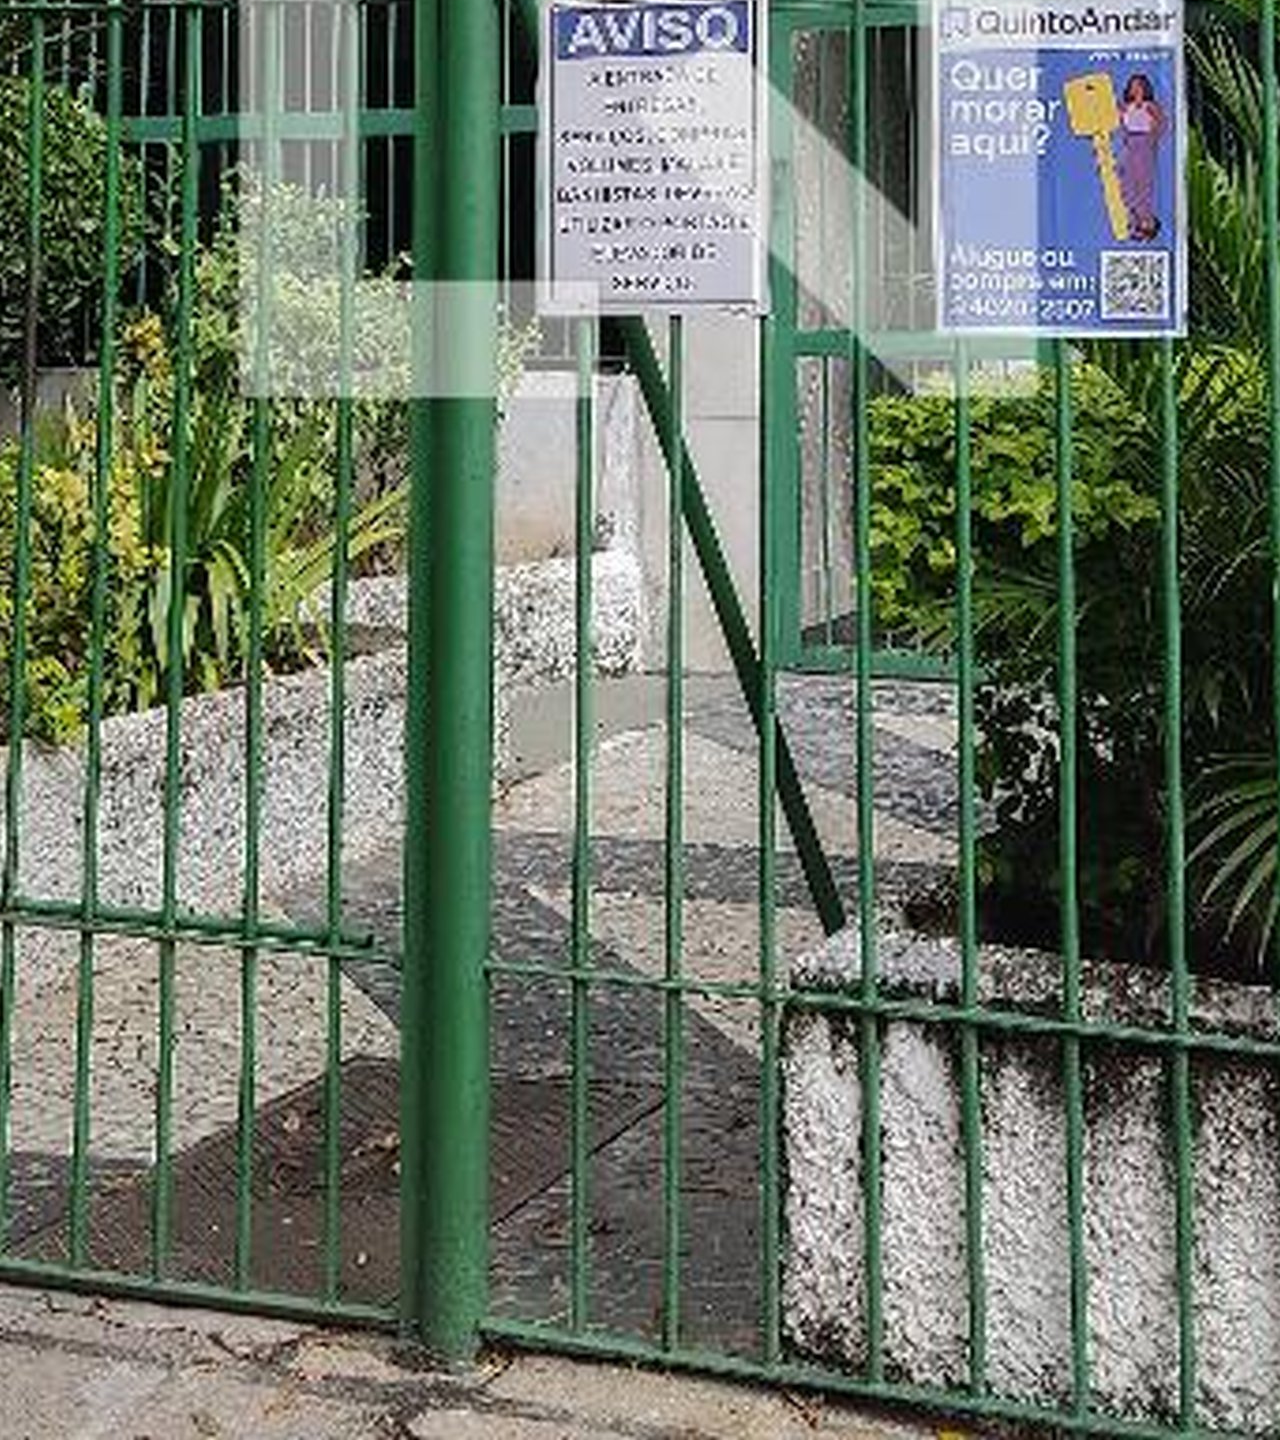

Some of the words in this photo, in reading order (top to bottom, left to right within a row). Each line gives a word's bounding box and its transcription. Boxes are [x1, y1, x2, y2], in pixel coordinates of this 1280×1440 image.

[568, 7, 739, 53] AVISO
[976, 6, 1176, 35] QuintoAndar
[950, 60, 1043, 92] Quer
[950, 99, 1061, 123] morar
[950, 122, 1052, 162] aqui?
[1040, 249, 1076, 268] ou
